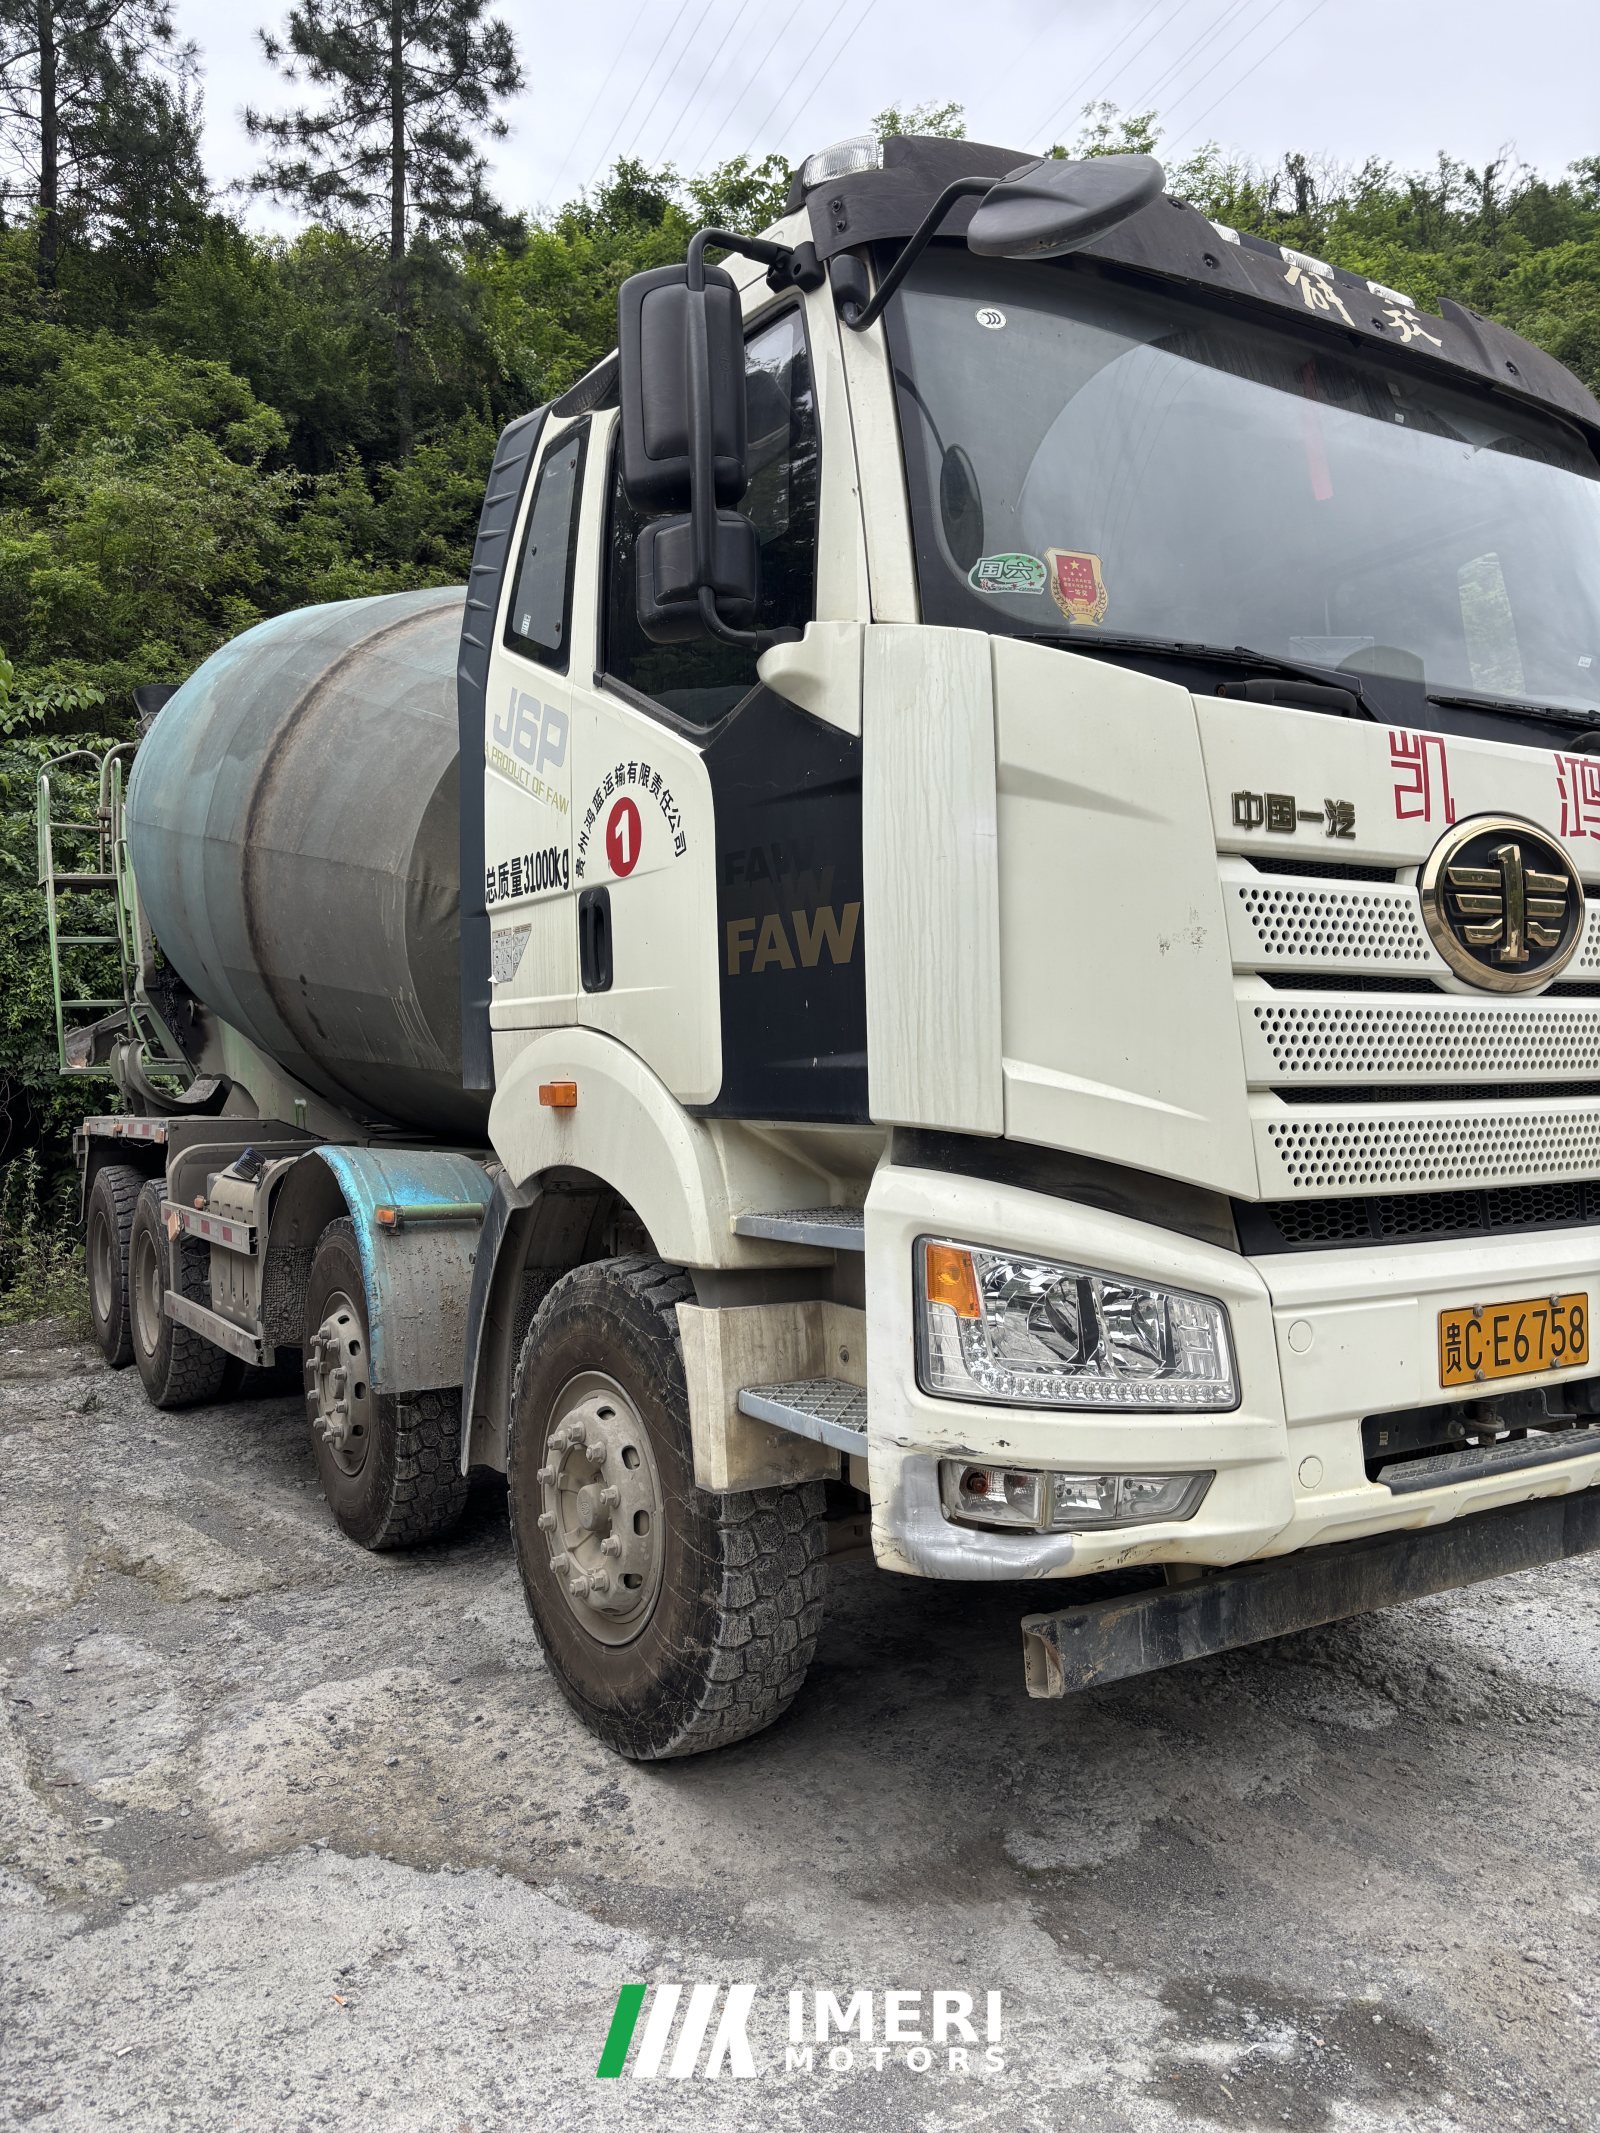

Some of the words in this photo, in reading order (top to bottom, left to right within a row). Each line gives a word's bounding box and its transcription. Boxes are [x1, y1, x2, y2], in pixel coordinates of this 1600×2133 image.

[977, 560, 1033, 580] 国六
[492, 686, 569, 774] J6P
[491, 746, 531, 787] PRODUCT
[531, 776, 545, 796] OF
[546, 786, 569, 815] FAW
[614, 808, 631, 864] 1
[1231, 790, 1356, 839] 中国一汽
[726, 902, 861, 976] FAW
